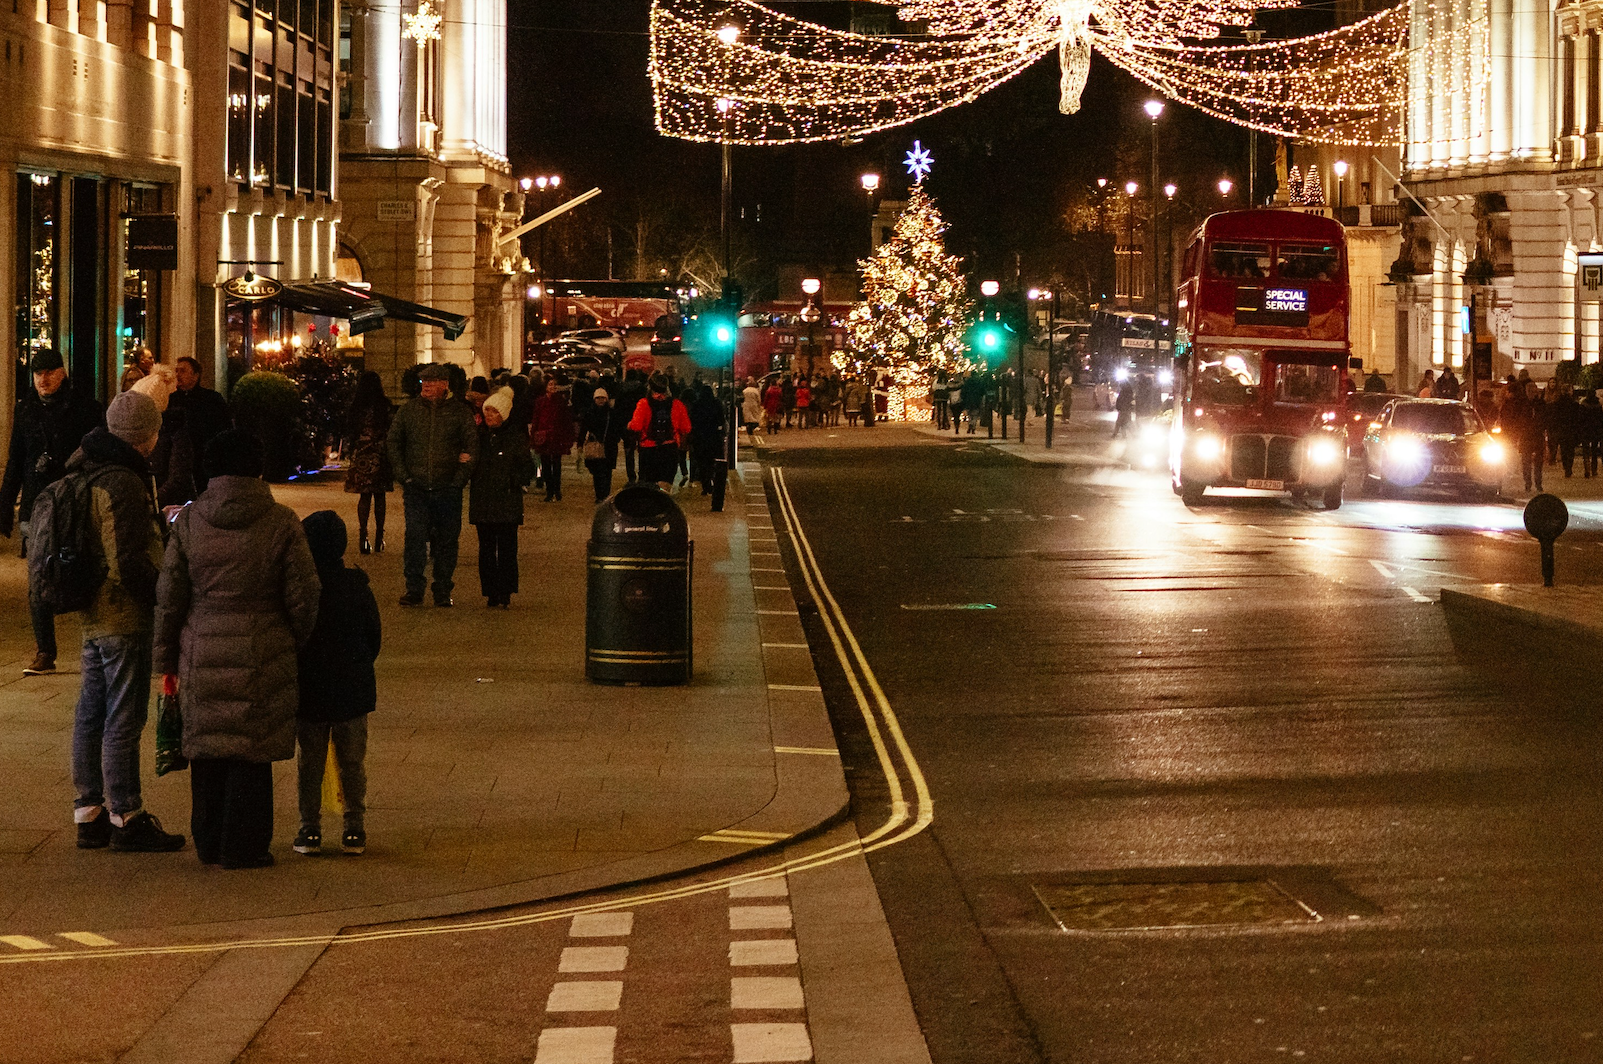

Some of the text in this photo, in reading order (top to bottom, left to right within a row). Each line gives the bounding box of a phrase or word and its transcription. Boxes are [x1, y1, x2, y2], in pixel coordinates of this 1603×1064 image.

[239, 286, 275, 294] CARLO
[1266, 290, 1306, 301] SPECIAL
[1266, 301, 1305, 311] SERVICE
